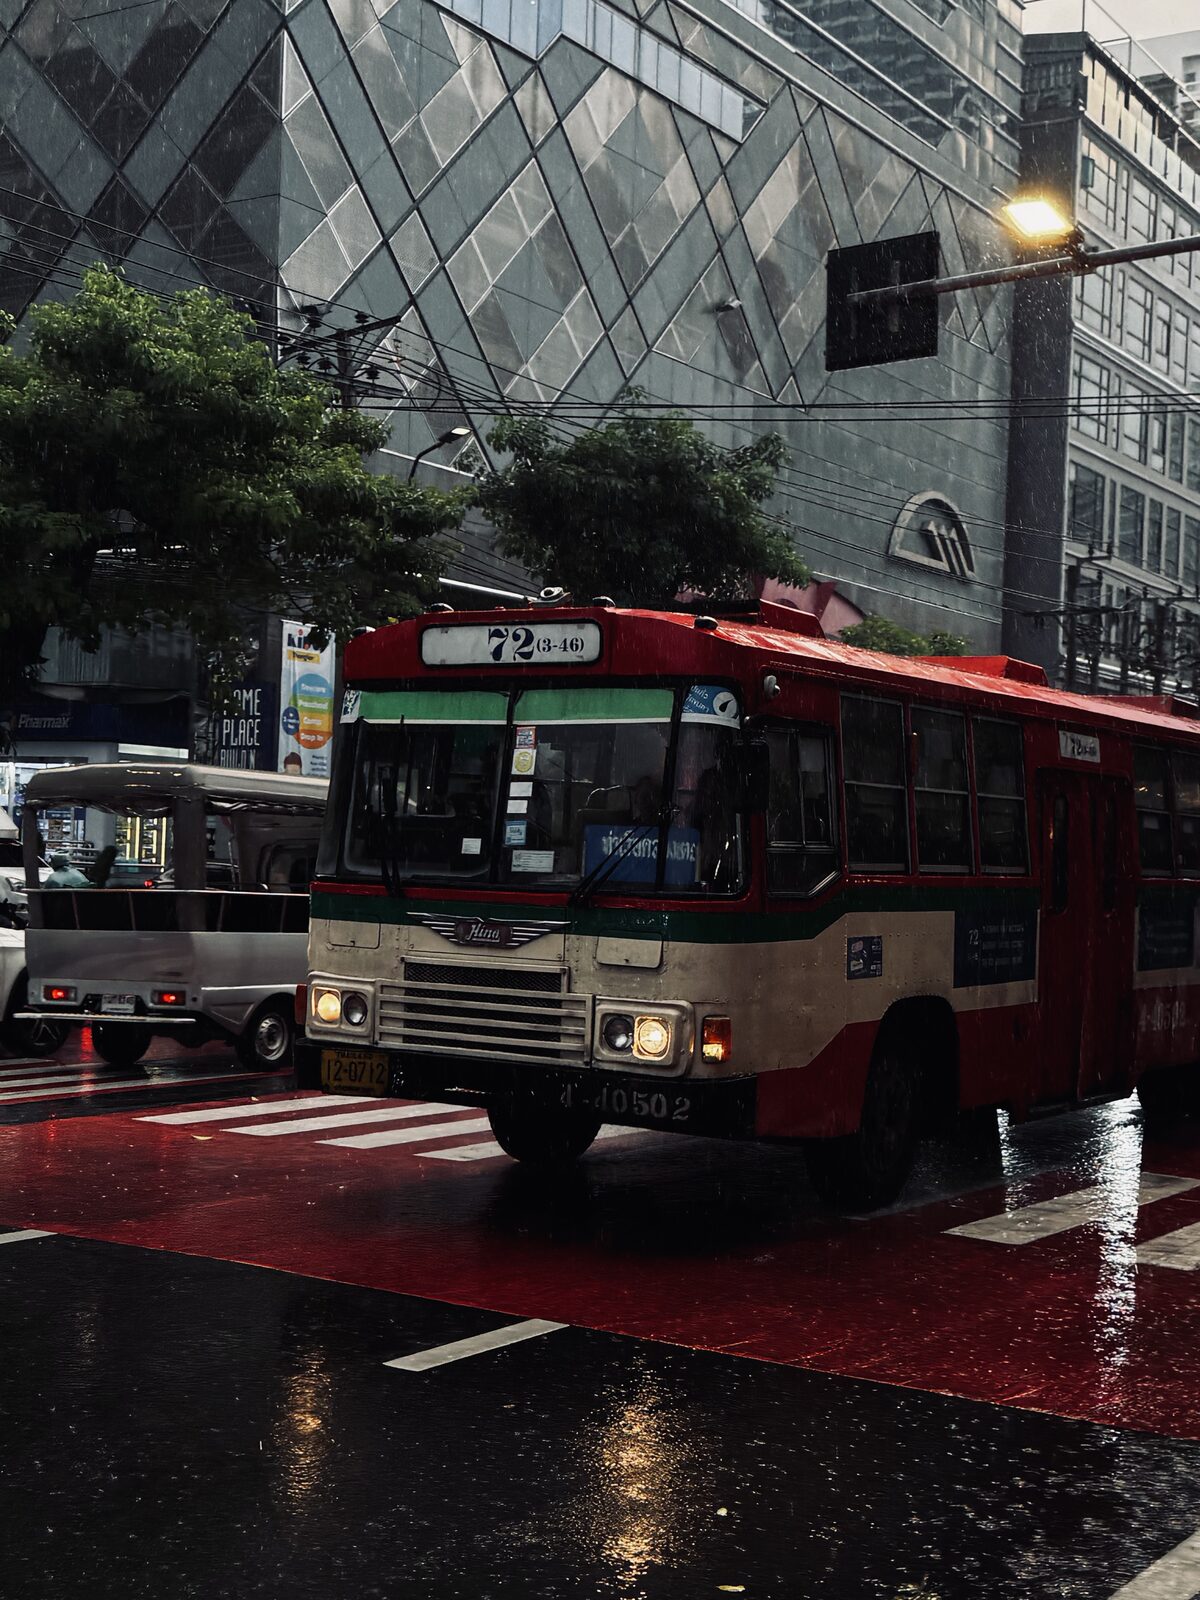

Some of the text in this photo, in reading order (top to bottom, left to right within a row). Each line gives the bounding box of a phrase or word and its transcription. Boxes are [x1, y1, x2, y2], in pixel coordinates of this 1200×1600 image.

[487, 627, 585, 661] 72 (3-46)
[222, 718, 262, 746] PLACE
[464, 923, 501, 943] Hino
[327, 1059, 385, 1084] 12-0712
